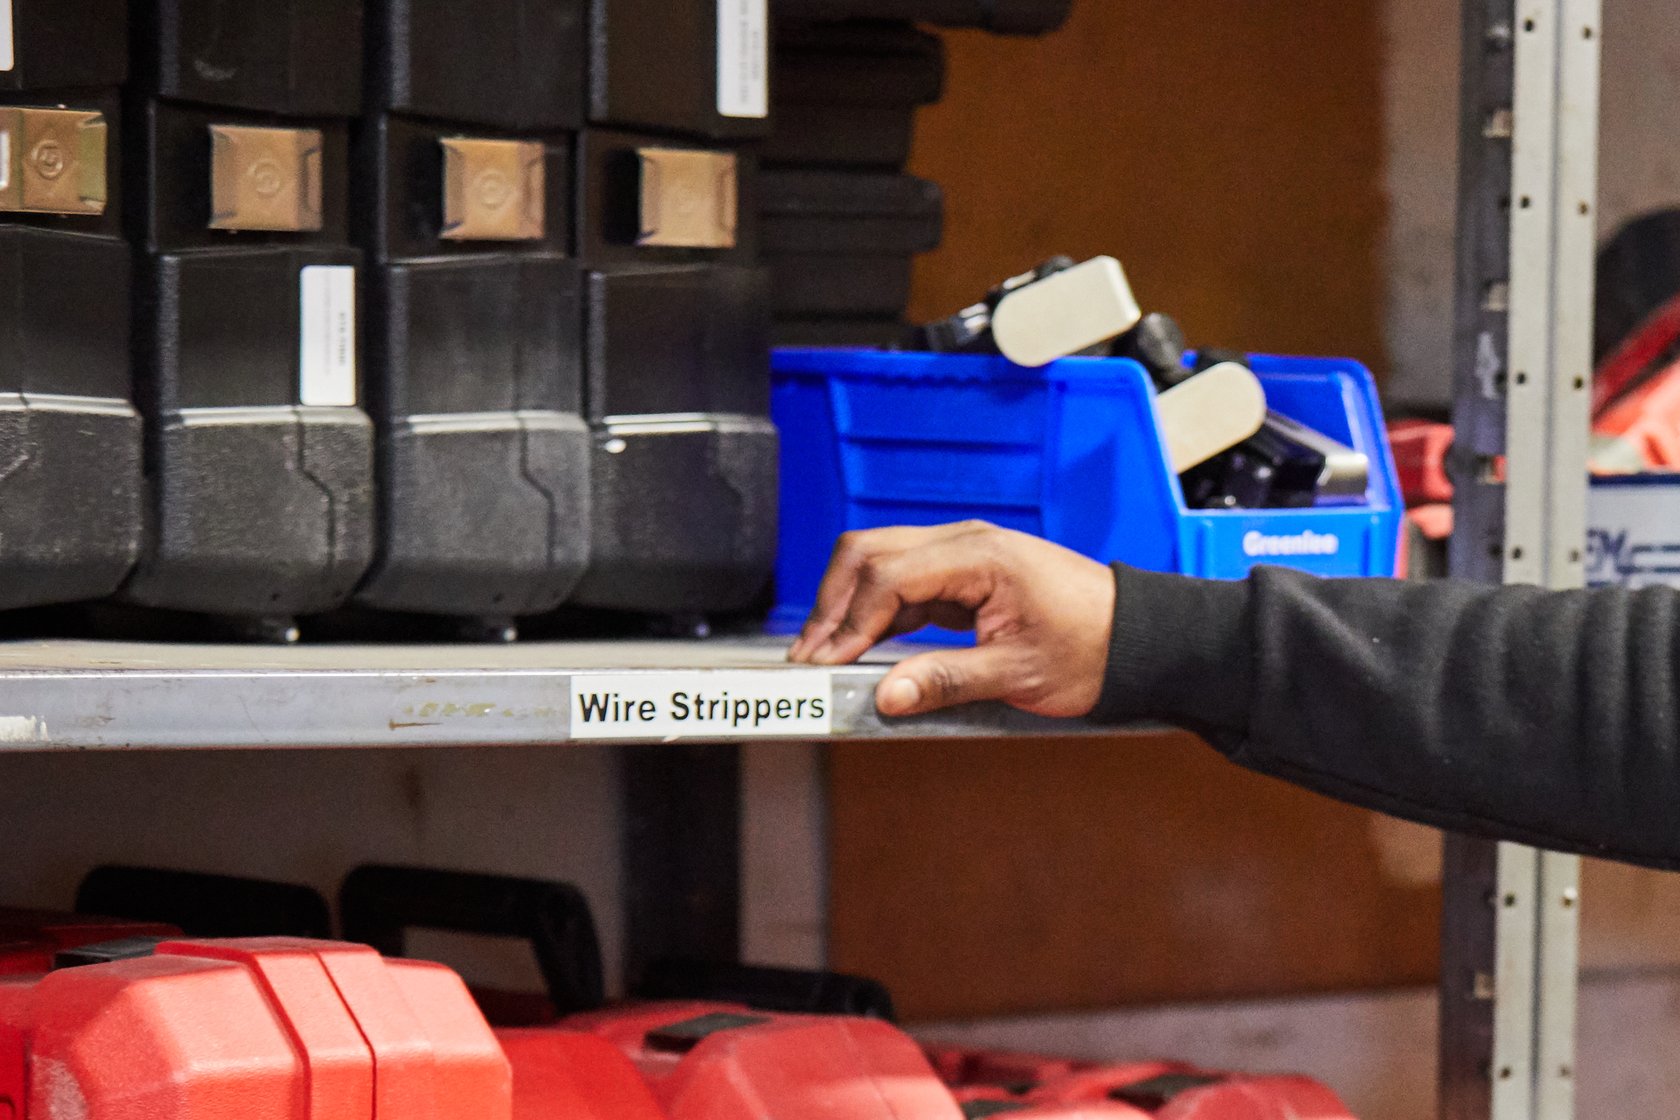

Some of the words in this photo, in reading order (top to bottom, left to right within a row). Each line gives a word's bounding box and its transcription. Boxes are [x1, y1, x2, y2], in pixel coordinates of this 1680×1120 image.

[1243, 529, 1339, 556] Greenlee
[579, 692, 656, 722] Wire
[670, 690, 825, 728] Strippers
